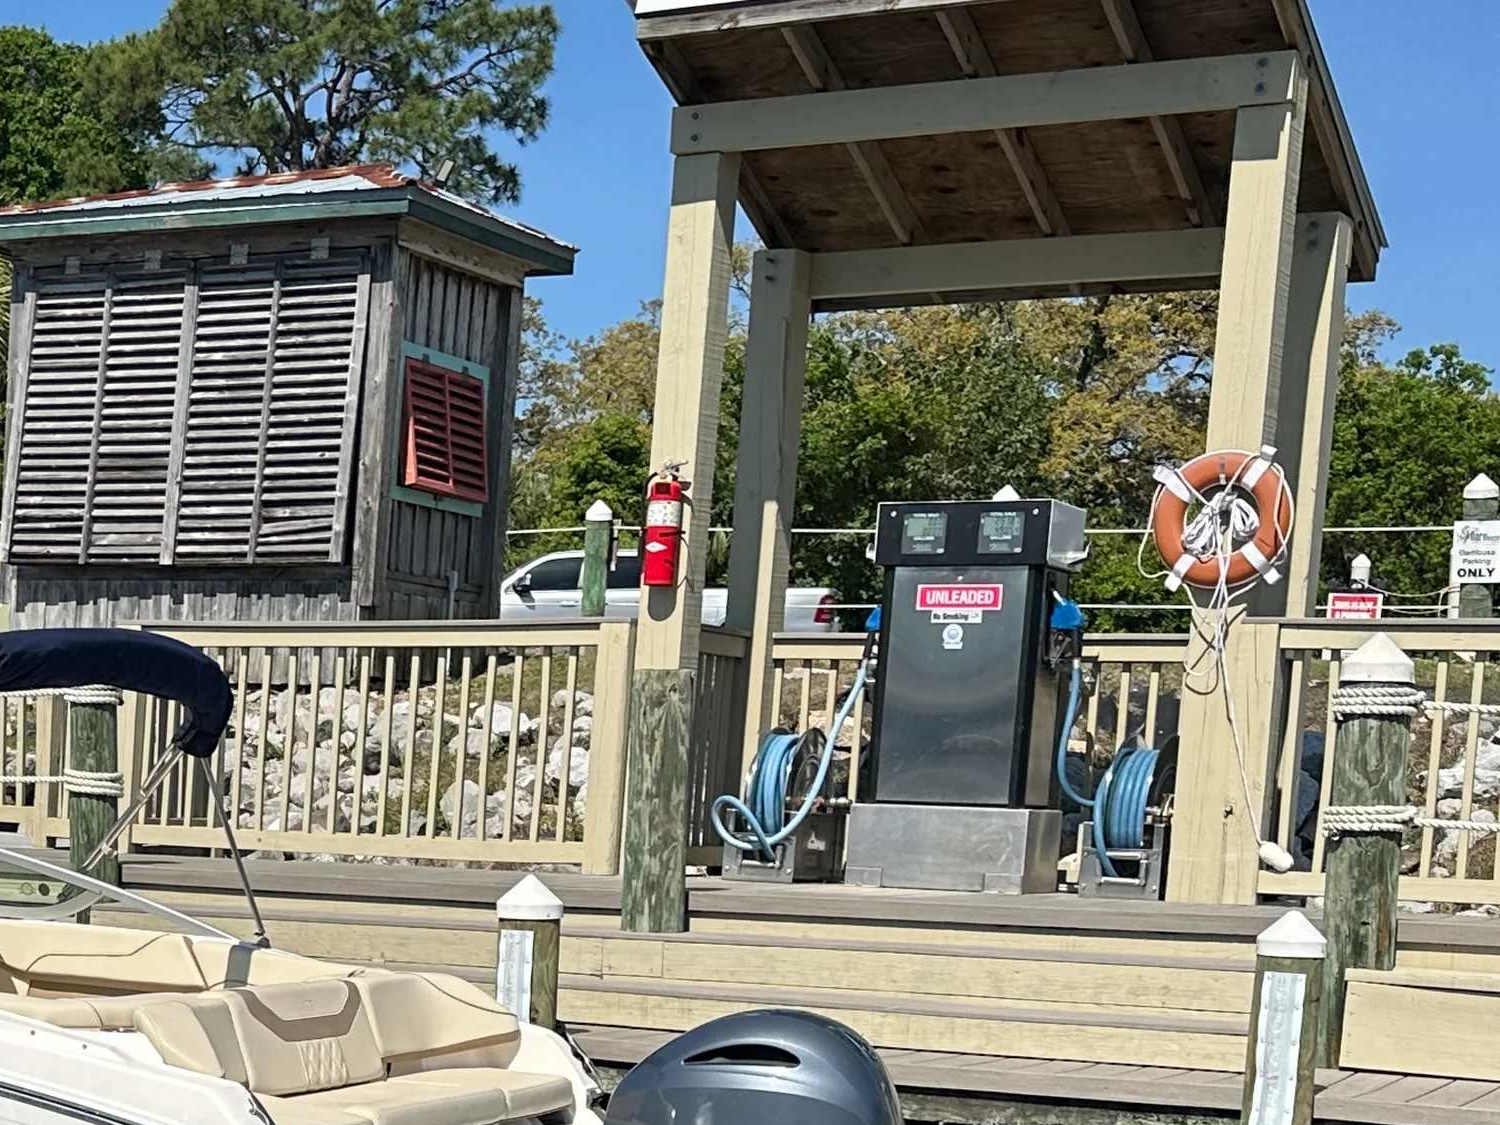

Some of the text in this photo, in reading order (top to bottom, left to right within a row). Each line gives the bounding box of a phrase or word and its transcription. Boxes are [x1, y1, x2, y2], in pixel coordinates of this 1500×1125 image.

[1462, 558, 1491, 566] Parking
[1457, 567, 1496, 578] ONLY
[926, 590, 995, 605] UNLEADED
[942, 612, 969, 621] Smoking
